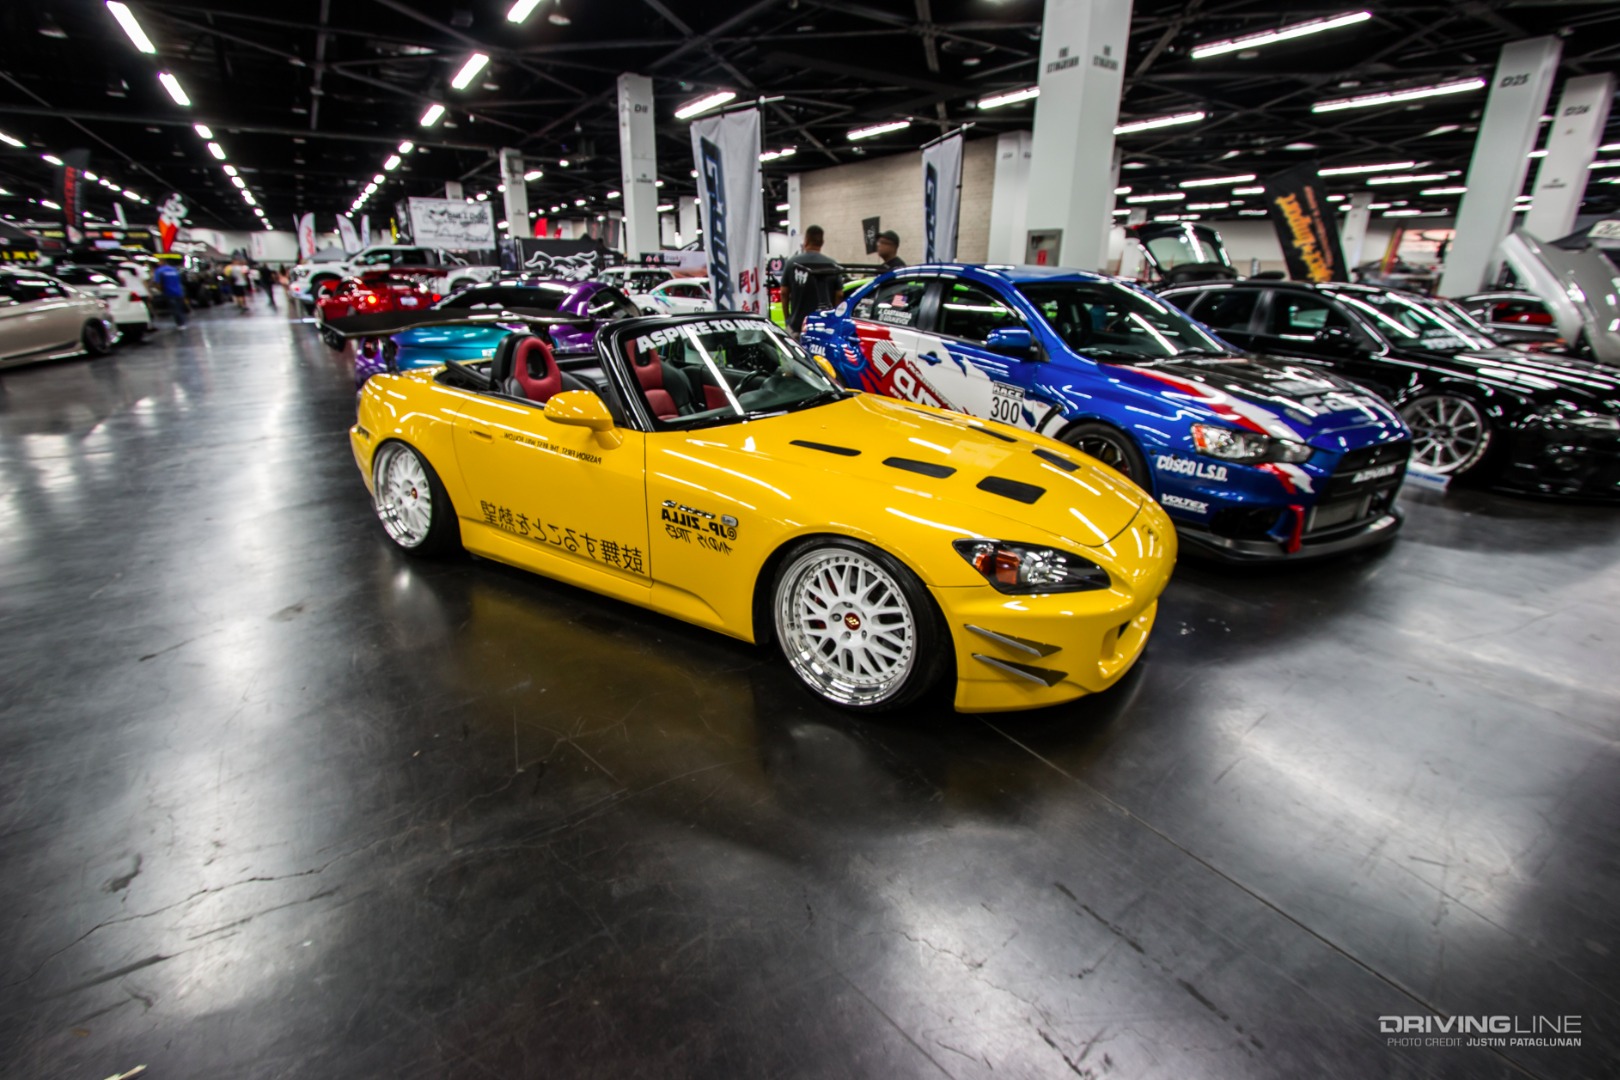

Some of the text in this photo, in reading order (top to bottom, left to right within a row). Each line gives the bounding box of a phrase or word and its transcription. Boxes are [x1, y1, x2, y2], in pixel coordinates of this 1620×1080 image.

[635, 320, 712, 353] ASPIRE
[709, 319, 736, 333] TO
[990, 396, 1020, 424] 300
[1162, 493, 1209, 511] VOLTEX
